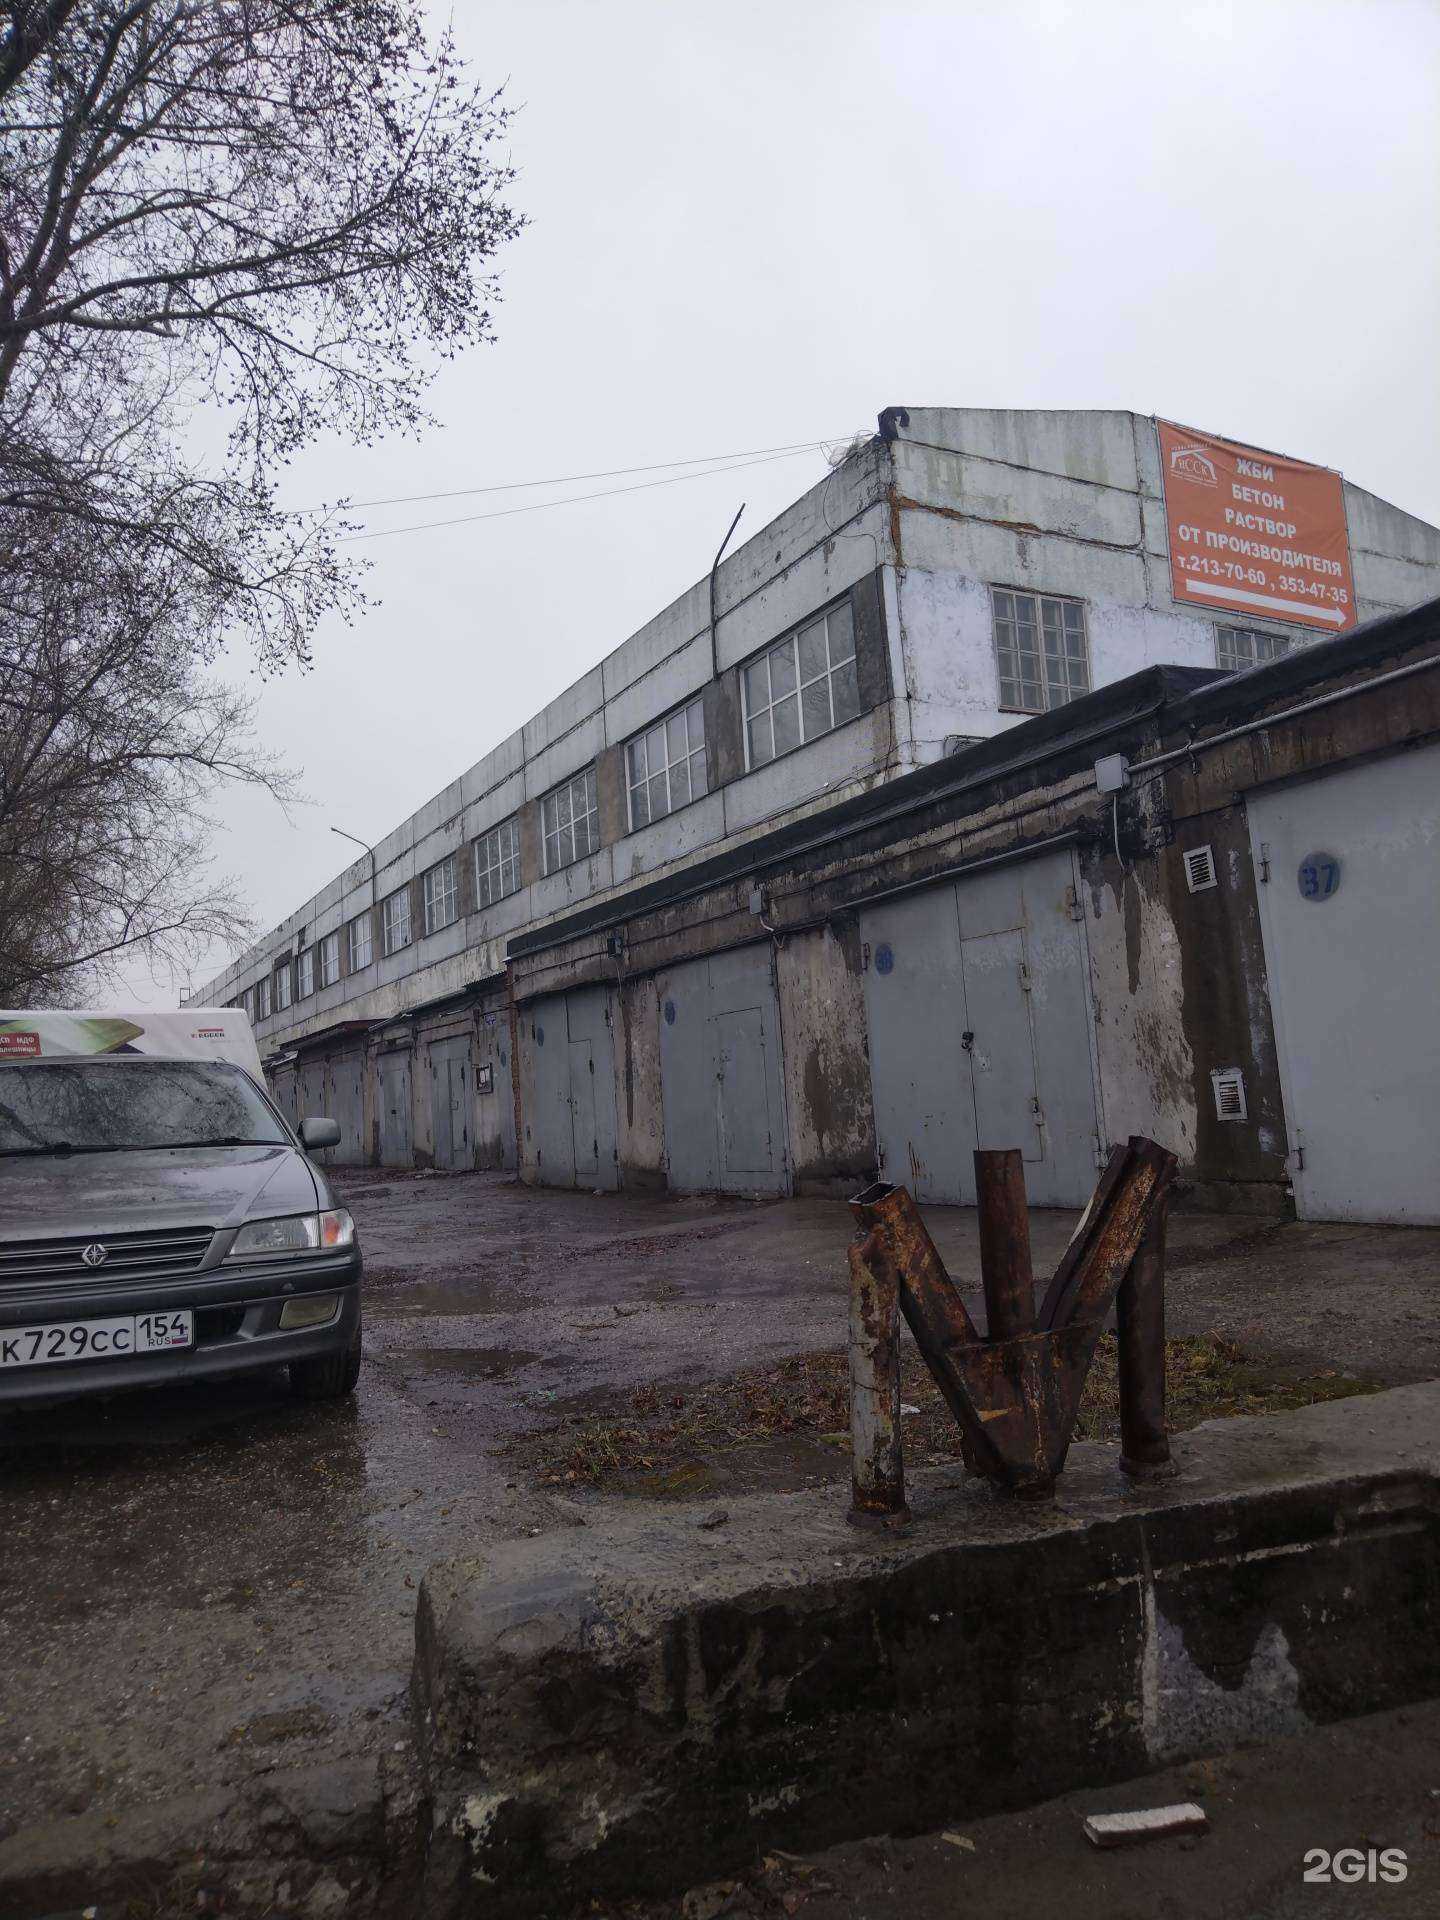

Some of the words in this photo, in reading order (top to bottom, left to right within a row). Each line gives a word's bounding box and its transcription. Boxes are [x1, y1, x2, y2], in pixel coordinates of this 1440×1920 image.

[1236, 458, 1274, 482] ЖБИ
[1232, 483, 1285, 511] БЕТОН
[1225, 508, 1297, 539] РАСТВОР
[1178, 524, 1200, 544] ОТ
[1206, 531, 1342, 577] ПРОИЗВОДИТЕЛЯ
[1279, 575, 1348, 604] 353-47-35
[1302, 863, 1335, 897] 37
[2, 1326, 130, 1362] К729СС
[139, 1314, 186, 1338] 154
[148, 1336, 171, 1347] RUS
